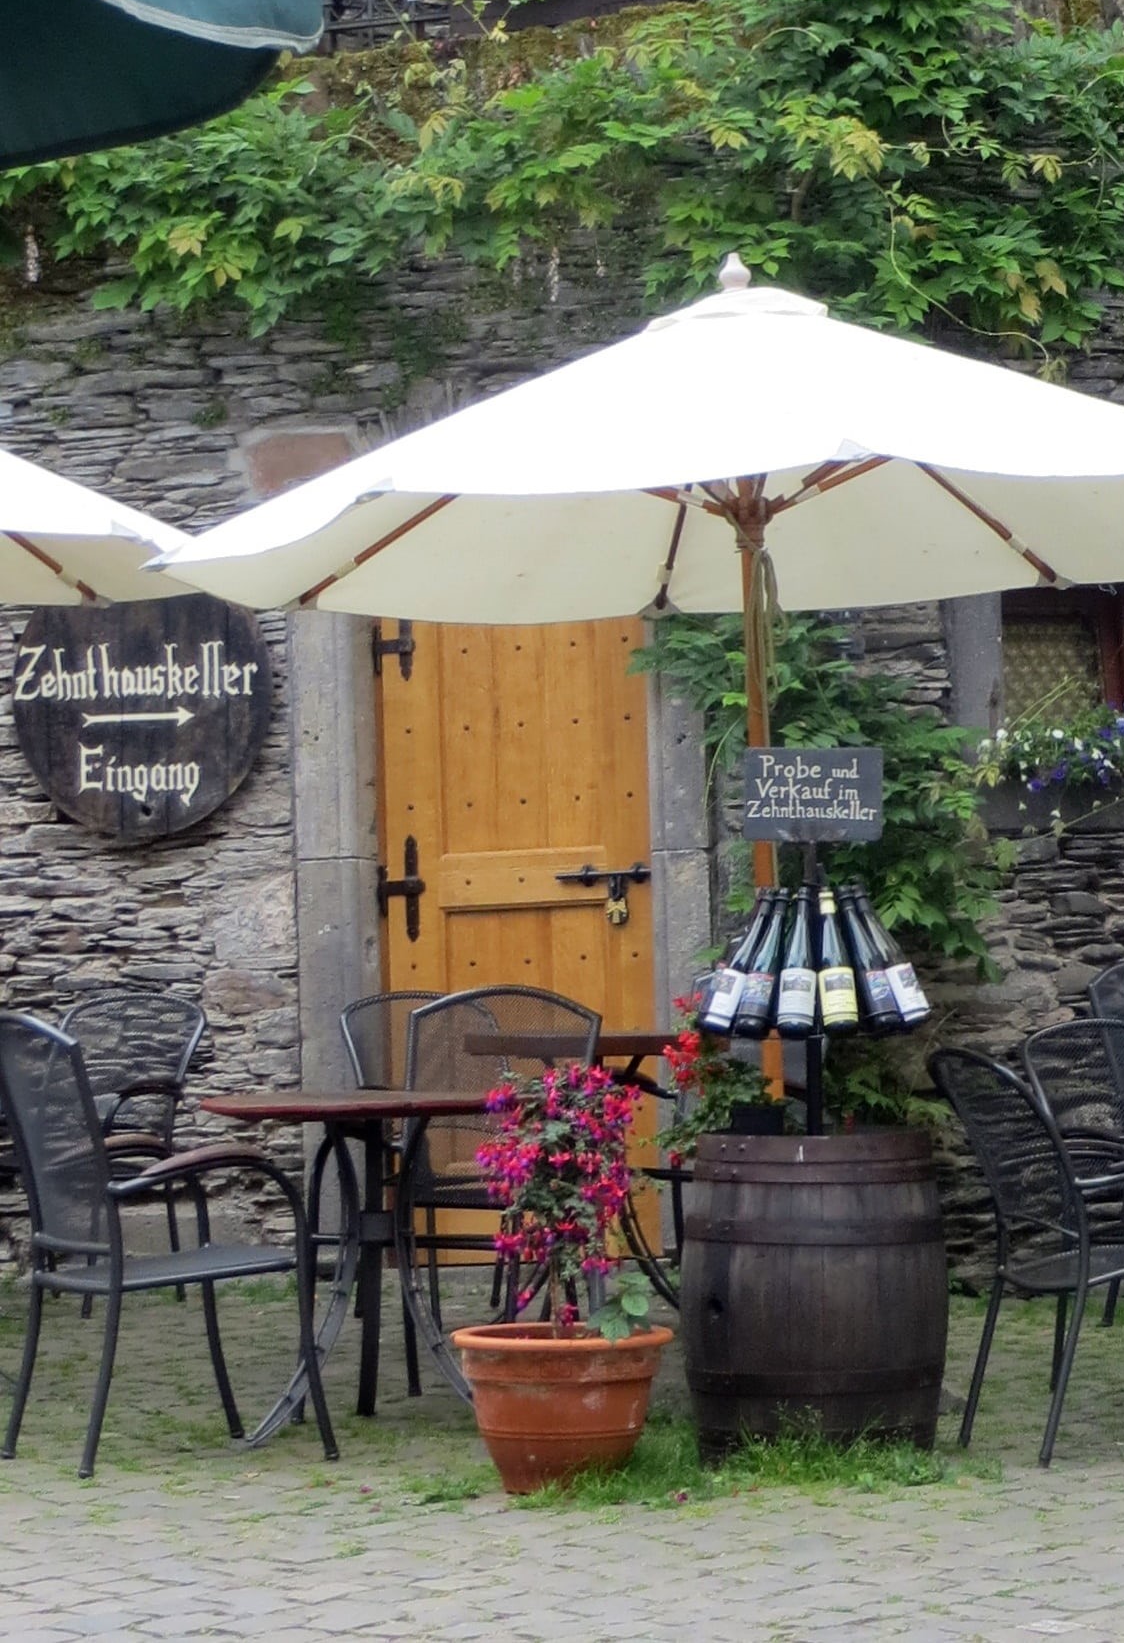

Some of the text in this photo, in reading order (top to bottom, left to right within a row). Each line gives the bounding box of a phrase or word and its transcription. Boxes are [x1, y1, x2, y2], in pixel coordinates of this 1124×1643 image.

[14, 641, 259, 701] Zehnthauskeller
[78, 742, 200, 807] Eingang
[759, 754, 860, 778] Probe und
[755, 778, 859, 800] Verkauf im
[746, 799, 878, 821] Zehnthauskeller
